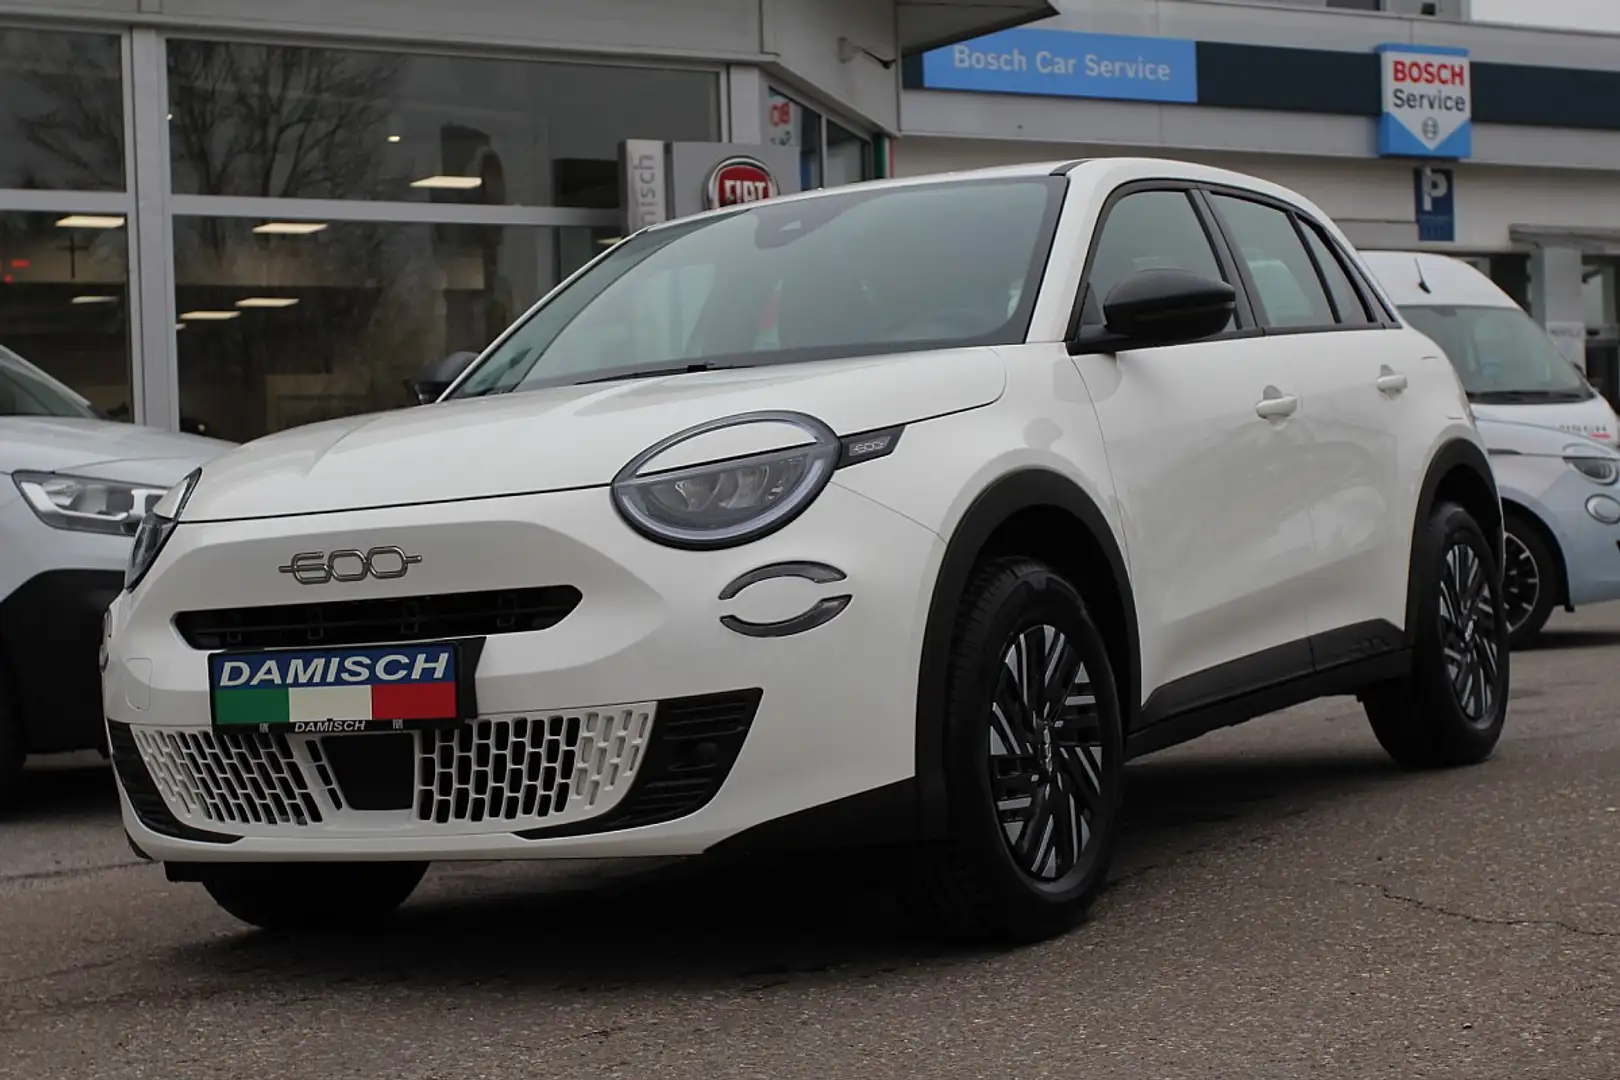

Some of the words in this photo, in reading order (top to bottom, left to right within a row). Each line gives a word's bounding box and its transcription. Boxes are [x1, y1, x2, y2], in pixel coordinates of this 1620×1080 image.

[953, 44, 1027, 71] Bosch
[1035, 51, 1077, 74] Car
[1084, 53, 1172, 81] Service
[1392, 60, 1465, 86] BOSCH
[1392, 88, 1466, 112] Service
[724, 179, 767, 203] FIAT
[1421, 171, 1448, 212] P
[278, 545, 422, 585] 600
[219, 652, 450, 687] DAMISCH
[294, 720, 366, 733] DAMISCH
